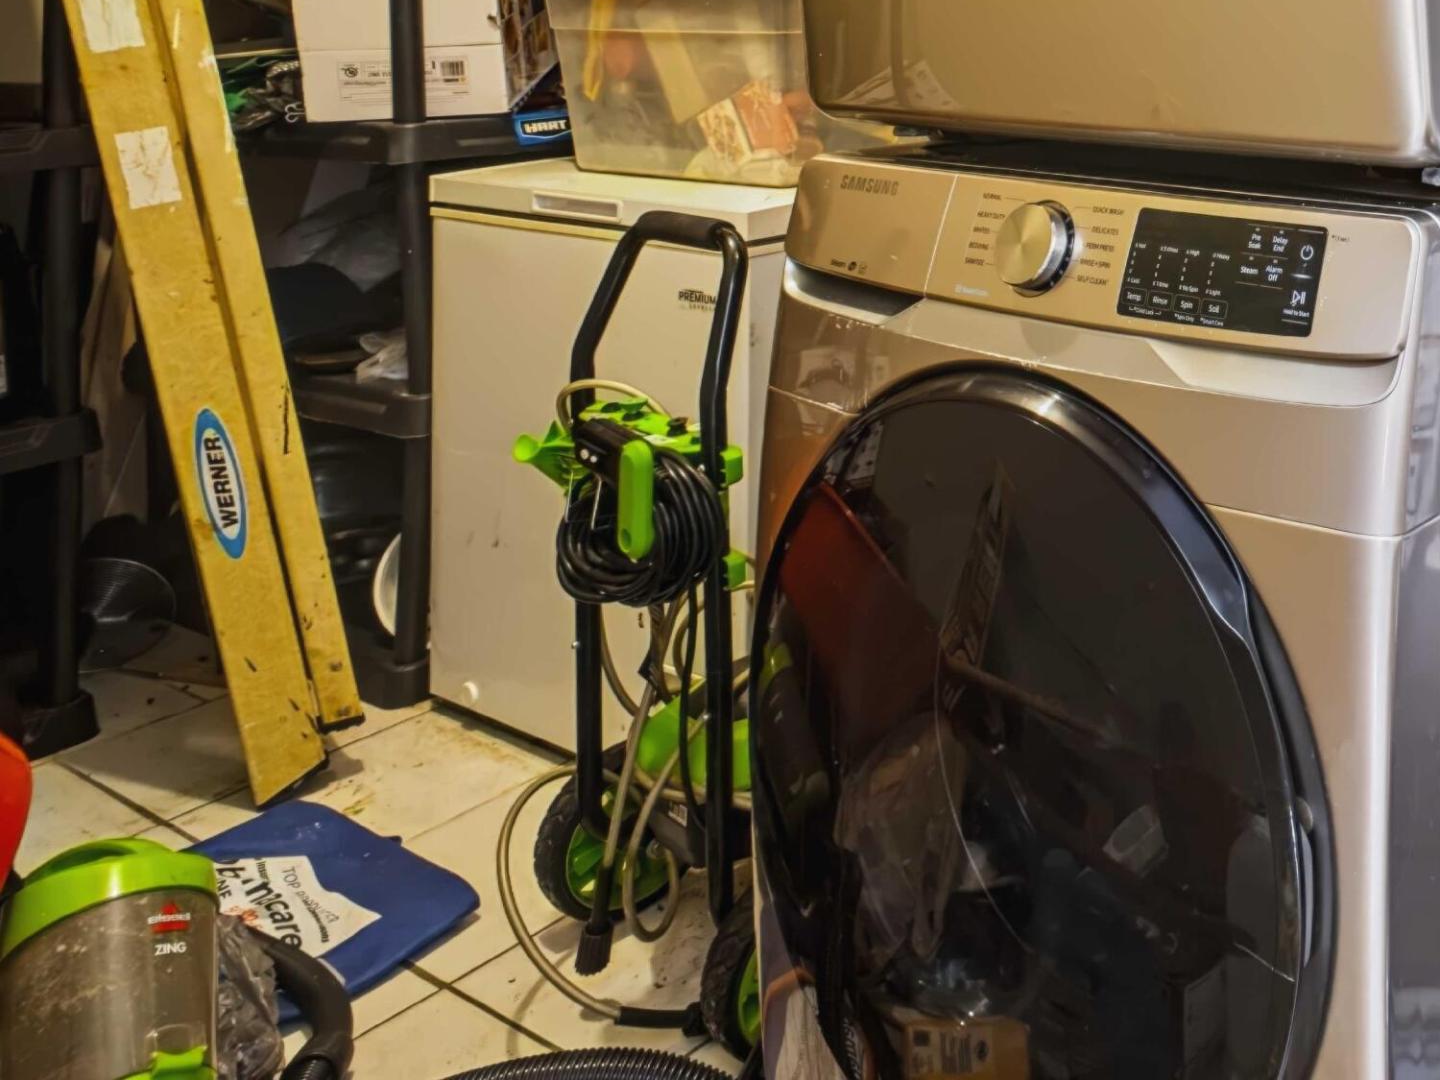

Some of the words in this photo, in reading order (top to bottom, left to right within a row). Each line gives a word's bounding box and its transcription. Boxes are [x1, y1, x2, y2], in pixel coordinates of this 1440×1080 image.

[840, 174, 900, 196] SAMSUNG
[678, 290, 716, 305] PREMIUM
[1180, 300, 1194, 310] Spin
[204, 436, 239, 529] WERNER
[154, 941, 187, 956] ZING
